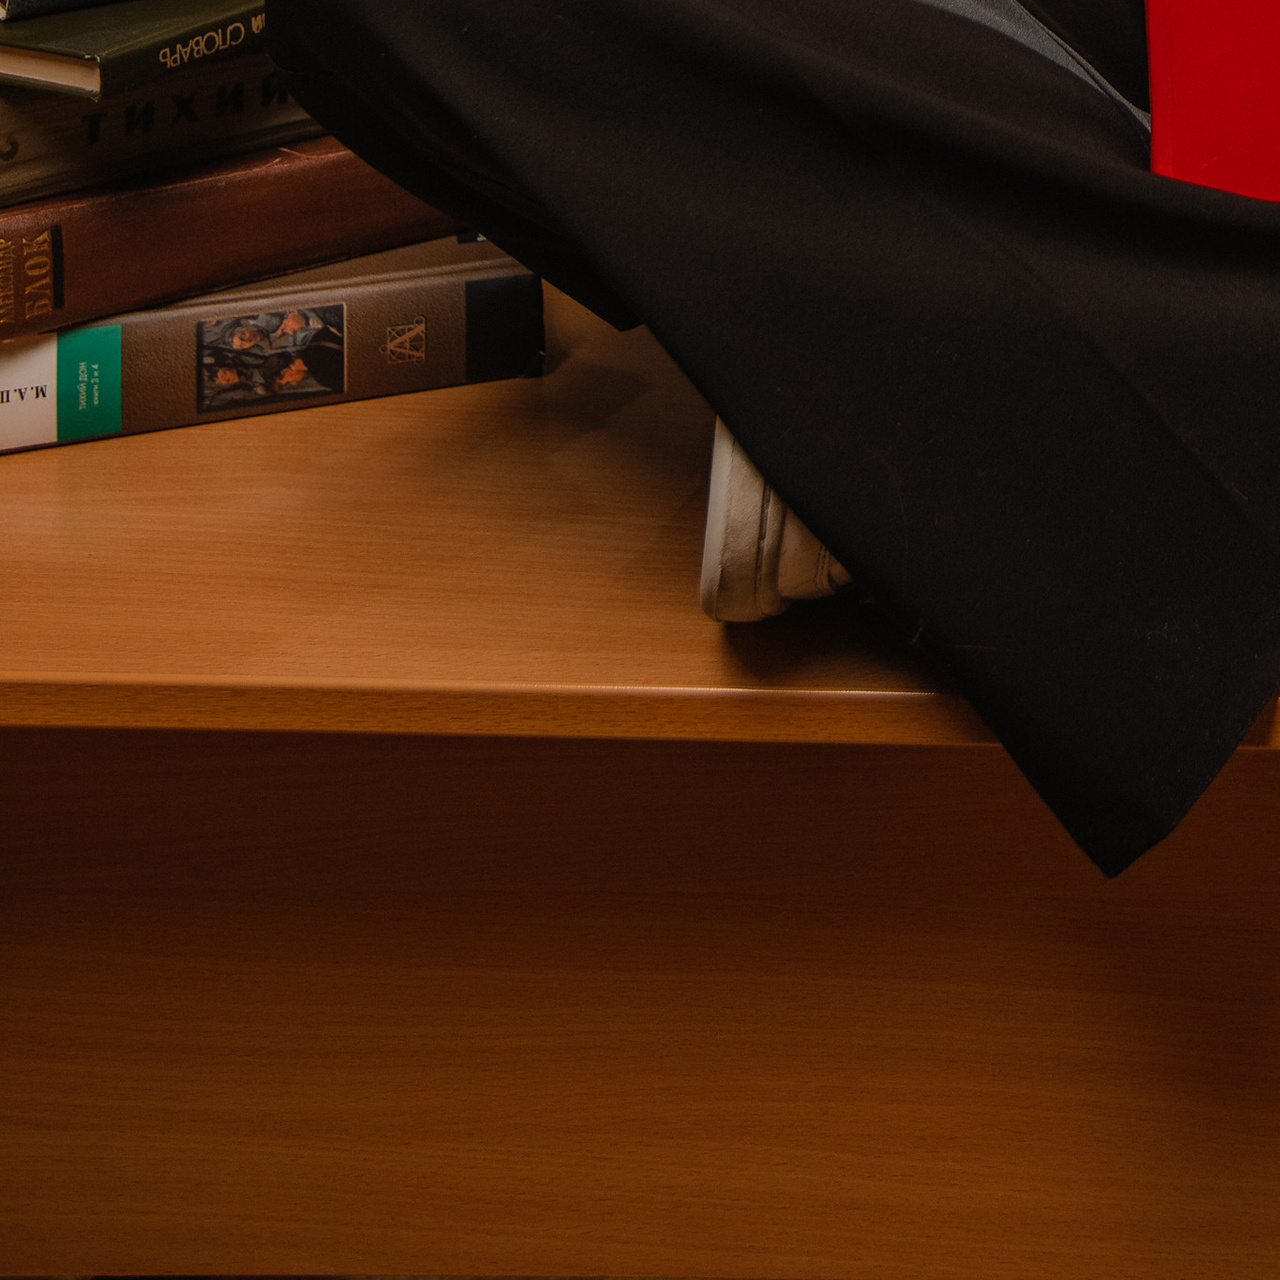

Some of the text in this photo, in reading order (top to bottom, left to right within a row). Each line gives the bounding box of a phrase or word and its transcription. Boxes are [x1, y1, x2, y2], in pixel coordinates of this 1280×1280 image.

[158, 22, 246, 69] СЛОВАРЬ
[80, 70, 291, 147] ТИХИЙ
[21, 231, 52, 320] БЛОК
[14, 387, 27, 401] А.
[31, 384, 47, 399] М.
[77, 361, 88, 410] ТИХИЙ ДОН
